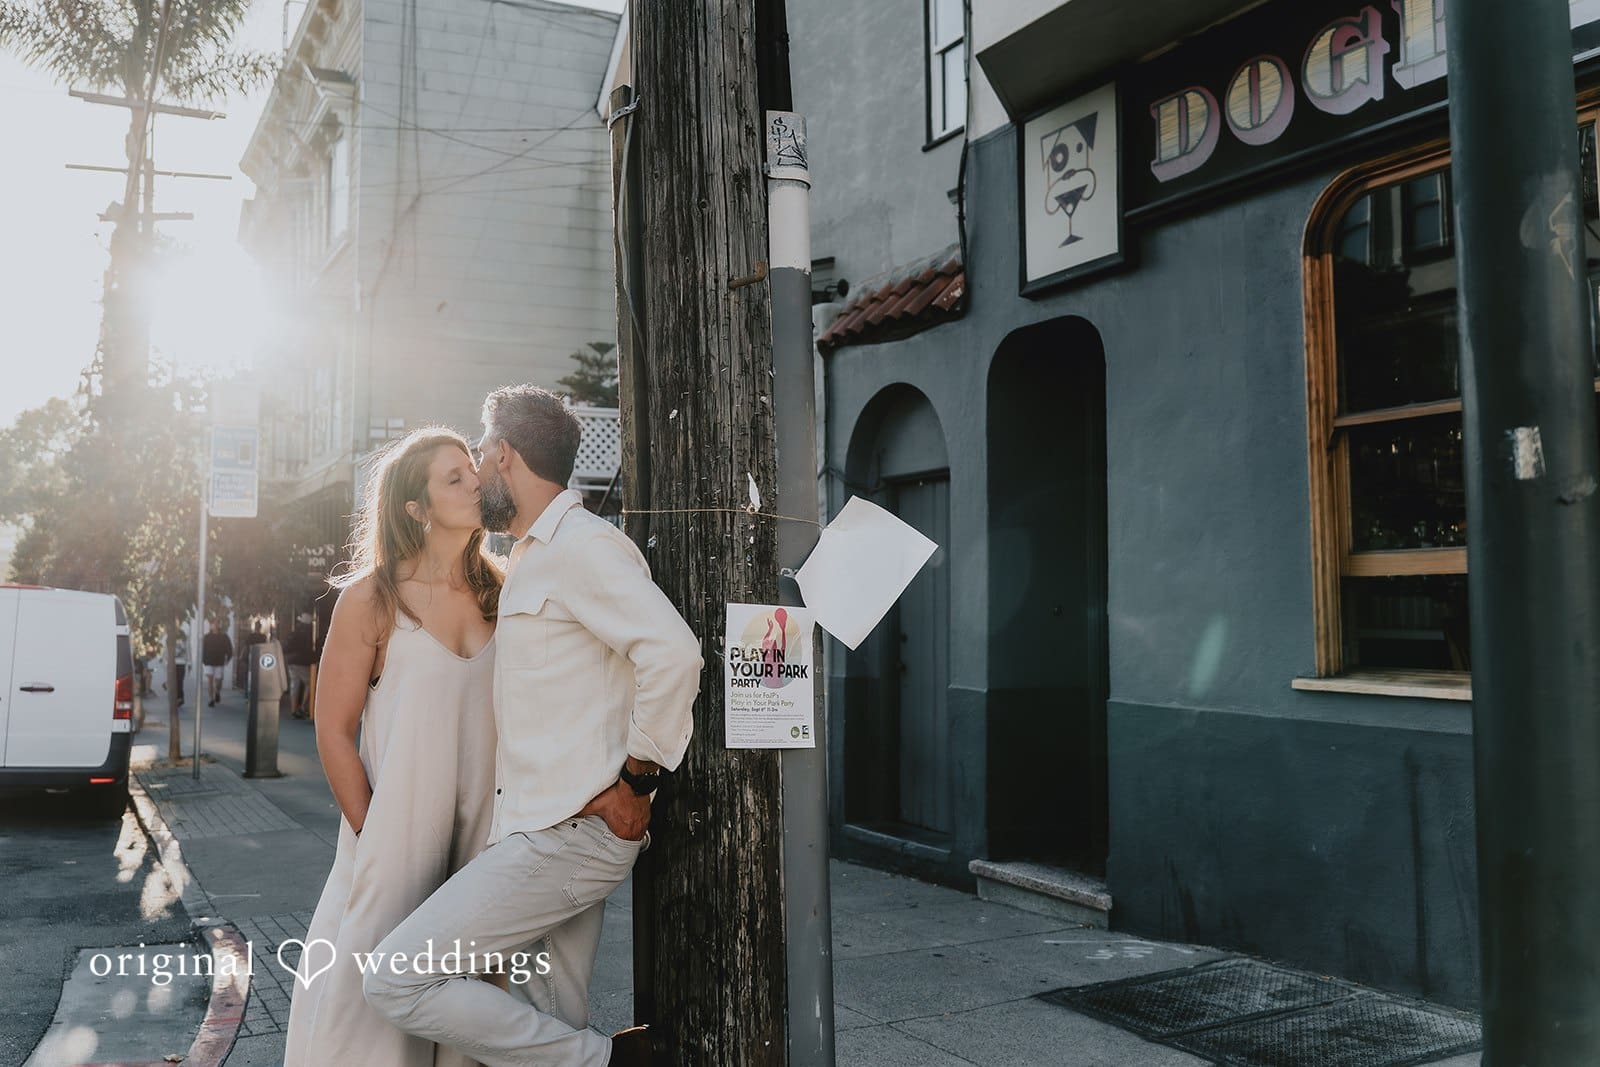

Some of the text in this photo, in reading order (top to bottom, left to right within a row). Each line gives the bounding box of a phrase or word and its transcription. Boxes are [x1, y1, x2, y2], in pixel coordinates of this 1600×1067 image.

[730, 647, 785, 663] PLAY IN
[730, 662, 808, 679] YOUR PARK
[731, 678, 762, 688] PARTY
[730, 699, 744, 707] Play
